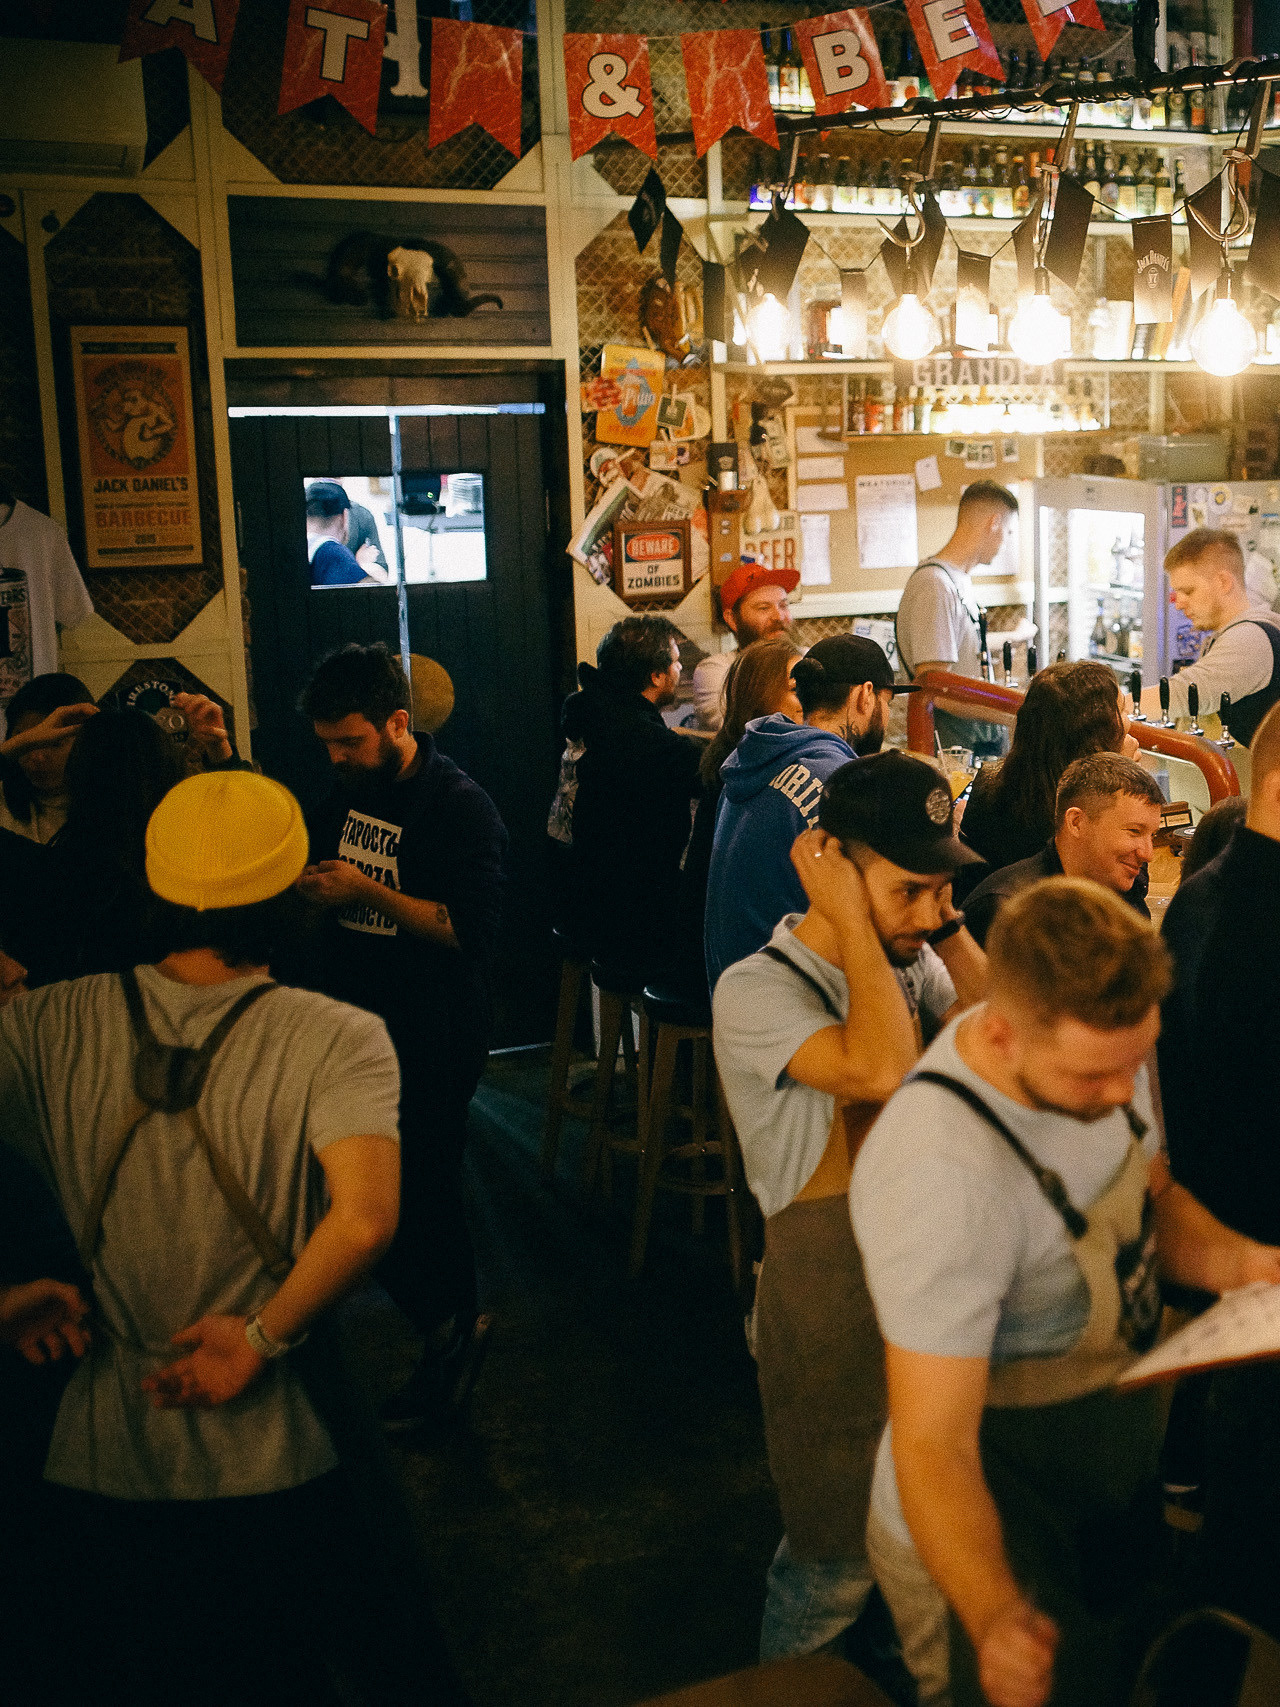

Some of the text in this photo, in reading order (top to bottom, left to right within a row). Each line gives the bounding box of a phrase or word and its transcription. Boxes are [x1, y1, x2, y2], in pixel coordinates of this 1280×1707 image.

[93, 478, 129, 493] JACK
[631, 537, 675, 557] BEWARE
[627, 574, 680, 589] ZOMBIES
